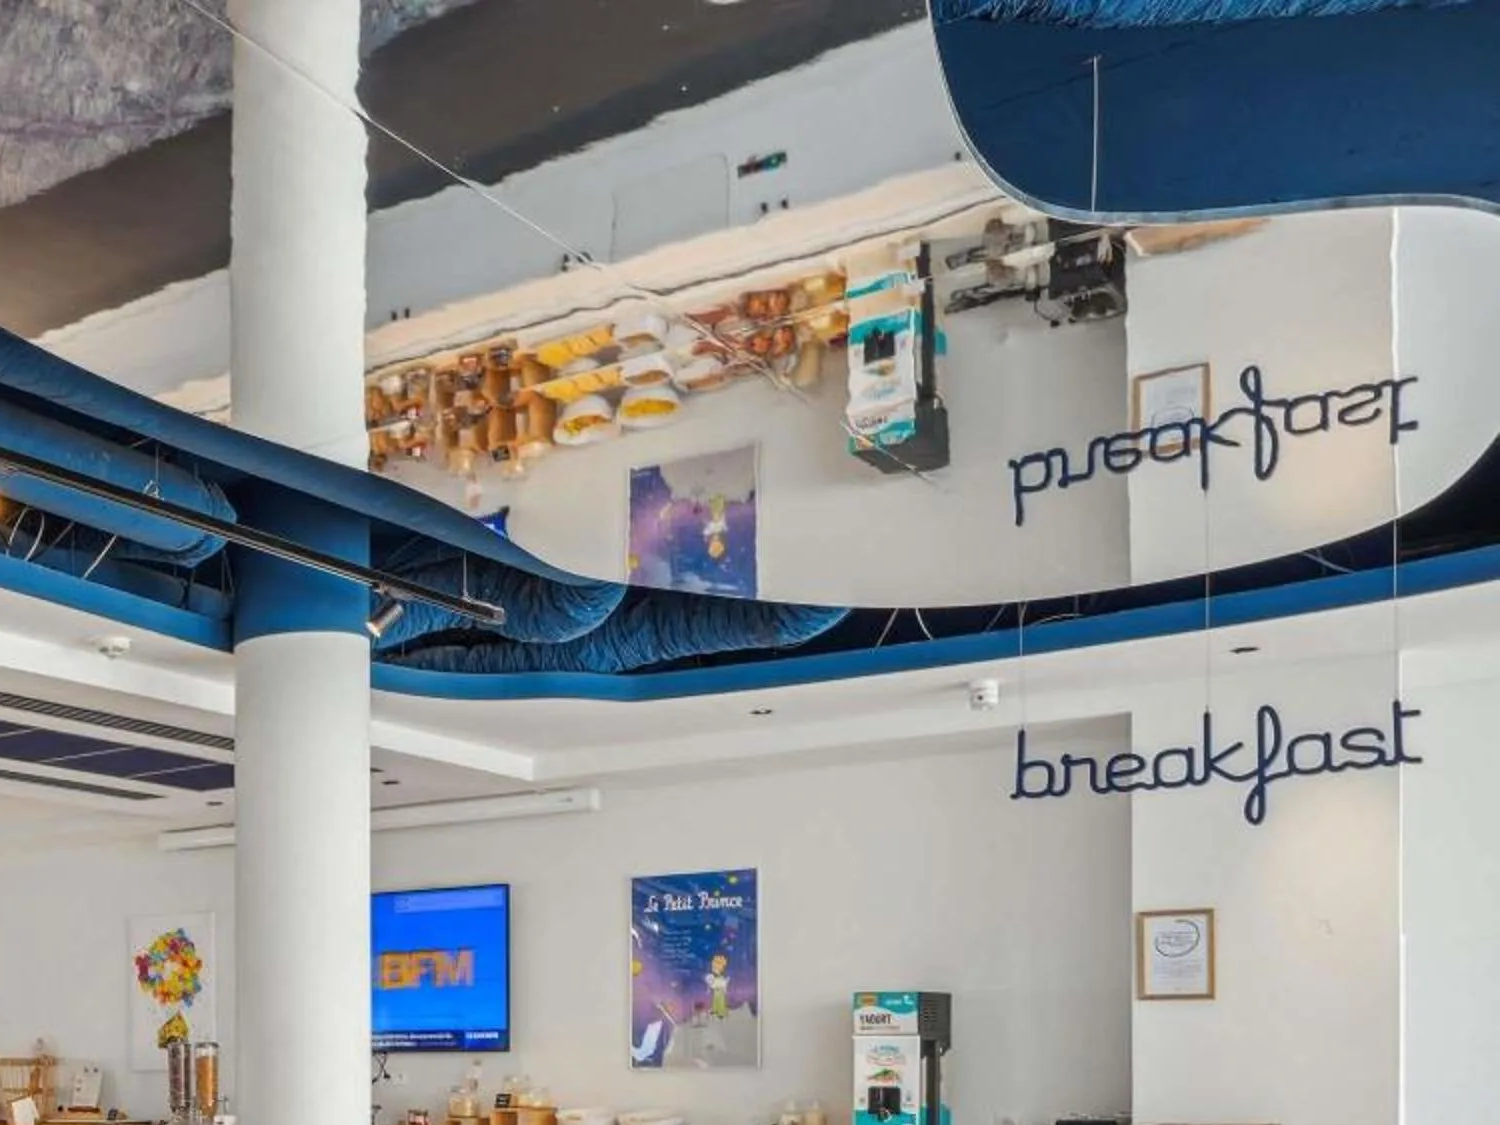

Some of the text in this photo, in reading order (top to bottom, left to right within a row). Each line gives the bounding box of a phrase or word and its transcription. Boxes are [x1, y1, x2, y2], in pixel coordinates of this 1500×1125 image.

[1010, 700, 1422, 824] breakfast
[663, 893, 694, 911] Petit
[698, 891, 742, 909] Prince
[380, 950, 474, 988] BFM
